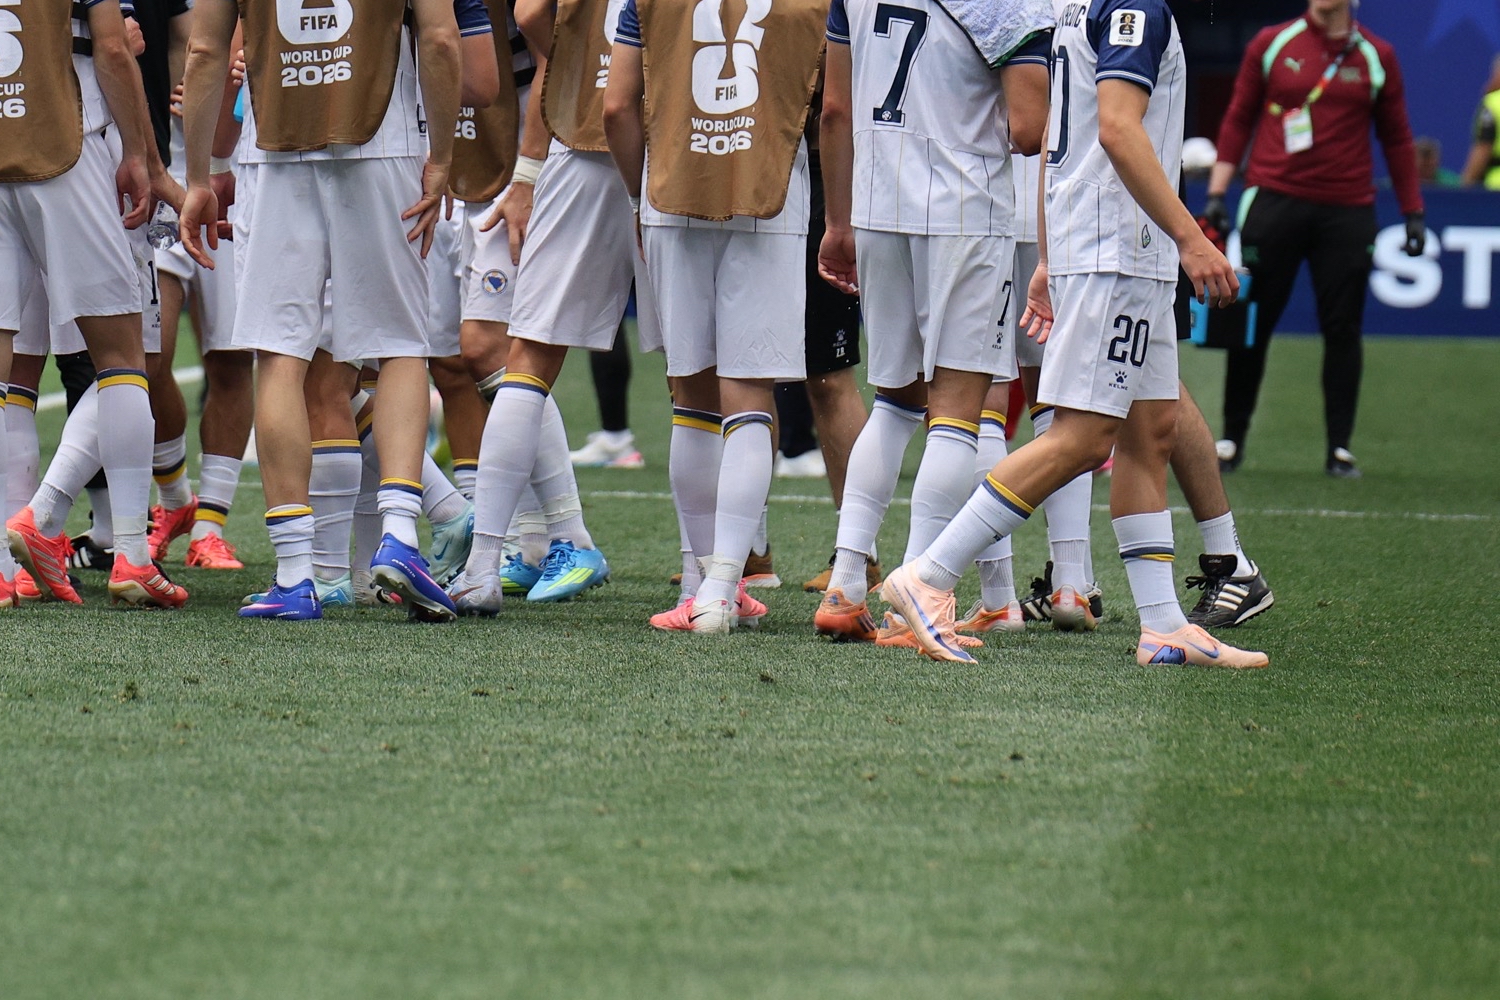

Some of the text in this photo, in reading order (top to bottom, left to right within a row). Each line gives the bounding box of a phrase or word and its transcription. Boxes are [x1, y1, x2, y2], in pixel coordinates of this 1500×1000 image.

[300, 14, 338, 31] FIFA
[280, 48, 332, 65] WORLD
[873, 2, 931, 127] 7
[281, 61, 352, 88] 2026
[715, 84, 738, 101] FIFA
[997, 280, 1012, 327] 7
[1107, 314, 1150, 369] 20
[1108, 381, 1129, 390] KELME
